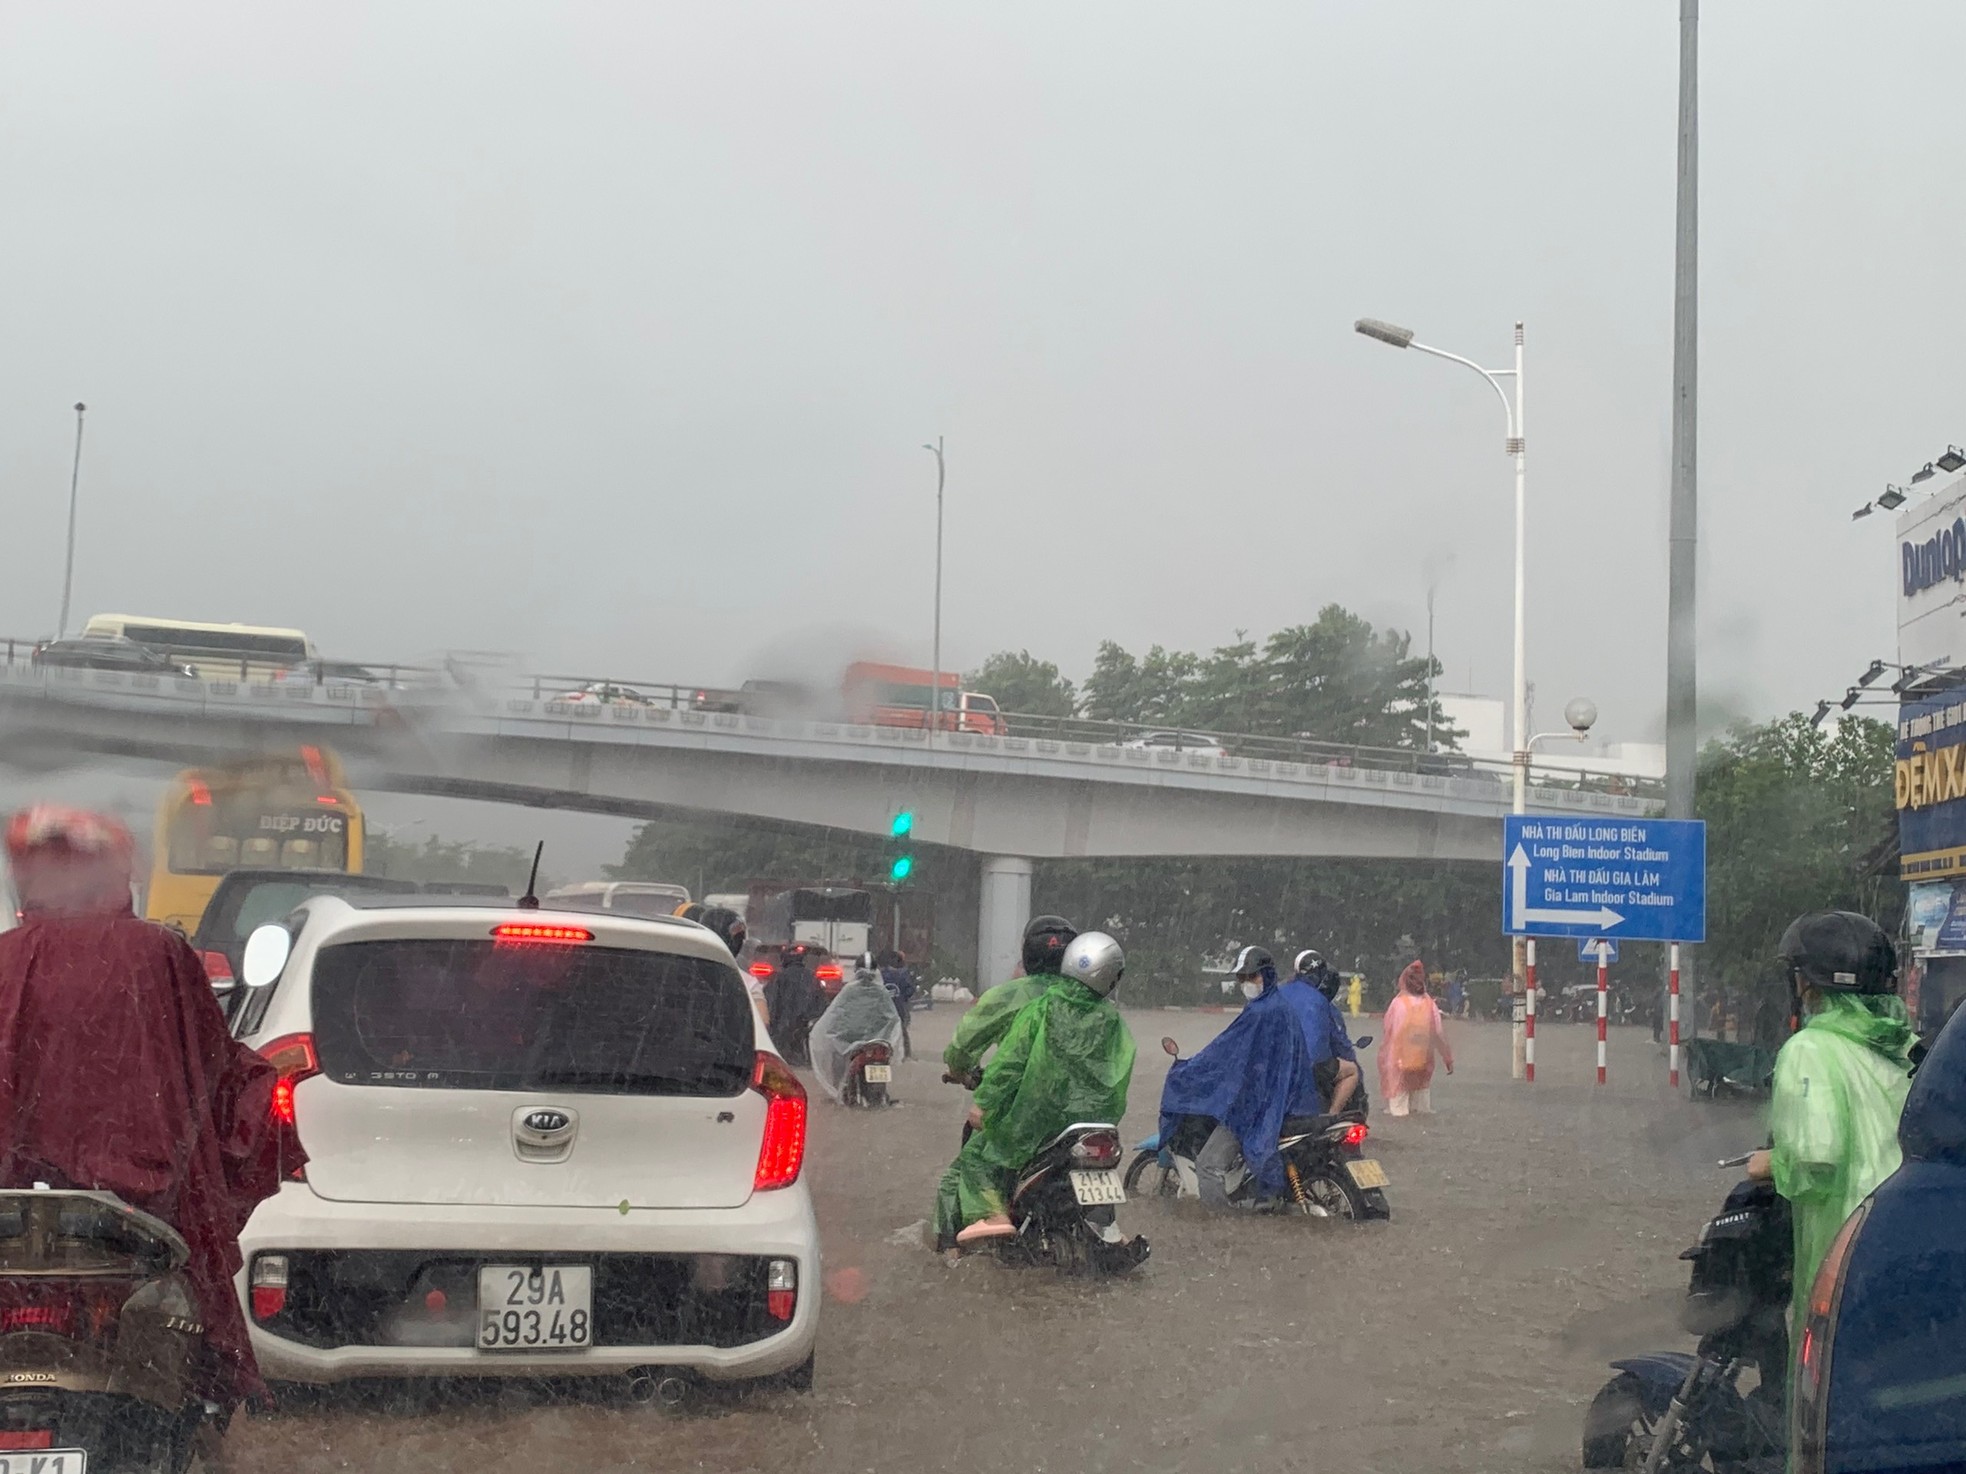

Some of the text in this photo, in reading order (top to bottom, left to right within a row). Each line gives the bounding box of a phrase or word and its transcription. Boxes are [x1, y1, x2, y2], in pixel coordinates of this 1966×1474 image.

[304, 814, 342, 833] ĐỨC
[1522, 821, 1646, 843] NHÀ THI ĐẤU LONG BIÊN
[1533, 843, 1669, 862] Long Bien Indoor Stadium
[1544, 866, 1660, 886] NHÀ THI ĐẤU GIA LÂM
[1544, 887, 1674, 906] Gia Lam Indoor Stadium
[532, 1112, 562, 1129] KIA
[1078, 1172, 1113, 1186] 21-K1
[507, 1269, 565, 1306] 29A
[481, 1308, 589, 1347] 593.48
